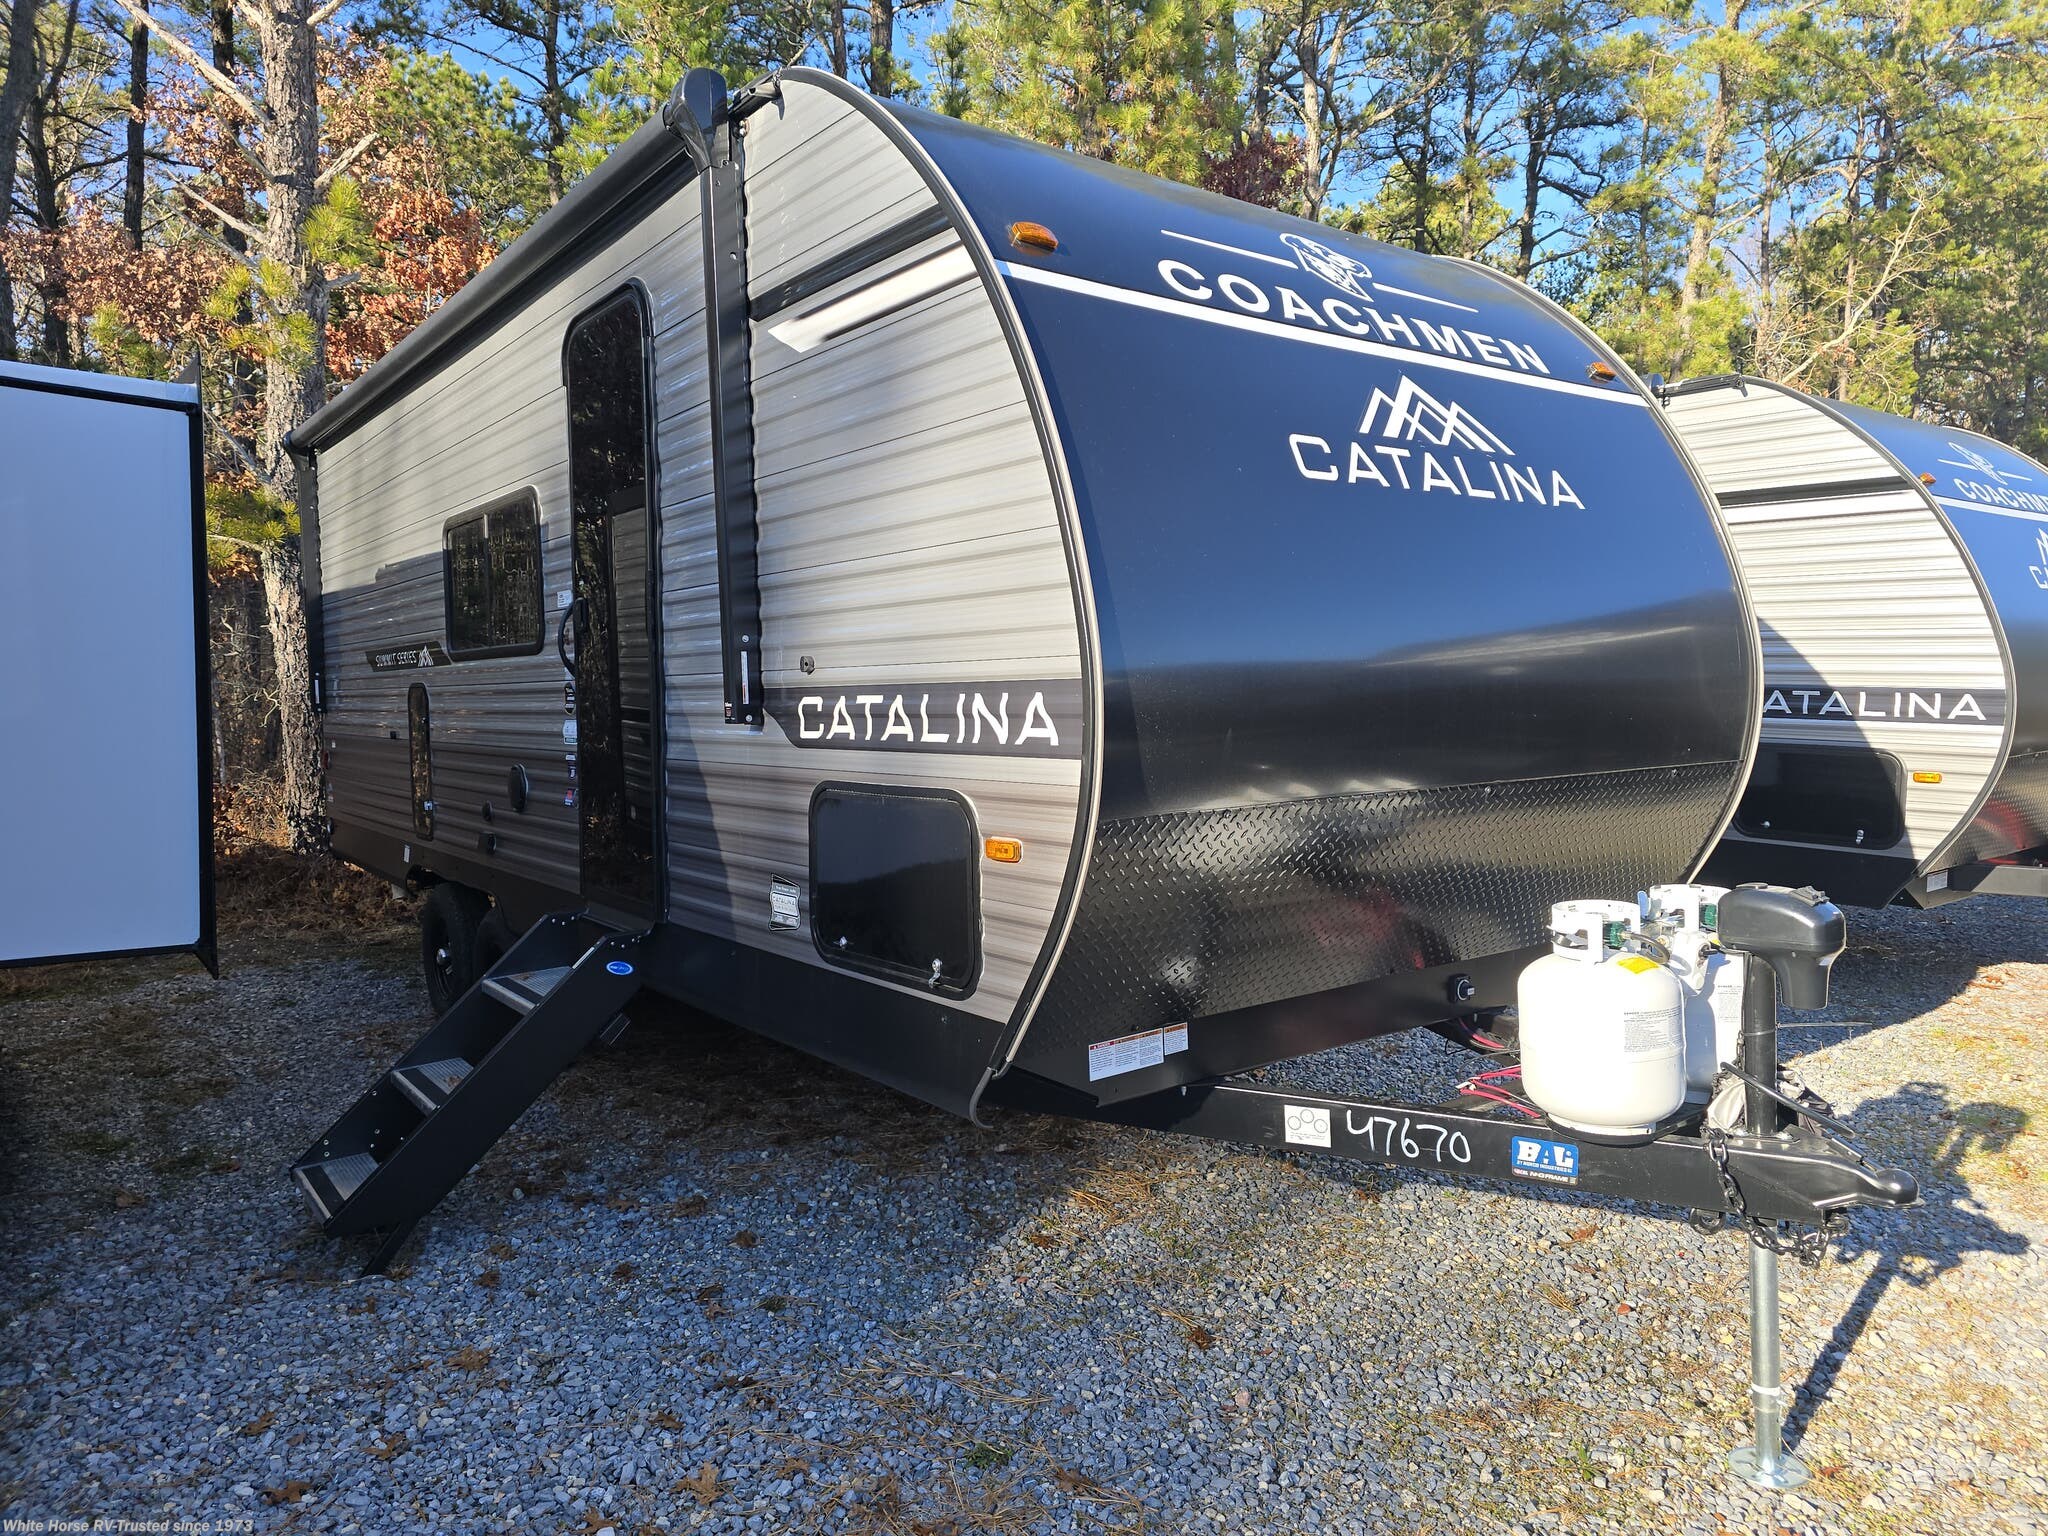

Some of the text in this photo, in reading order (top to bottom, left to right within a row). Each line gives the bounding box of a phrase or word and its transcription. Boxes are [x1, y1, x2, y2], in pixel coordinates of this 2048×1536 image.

[1157, 259, 1550, 374] COACHMEN
[1289, 433, 1586, 510] CATALINA
[397, 650, 417, 665] SERIES
[797, 692, 1059, 746] CATALINA
[1763, 690, 1987, 721] ATALINA
[1346, 1109, 1472, 1163] 47670
